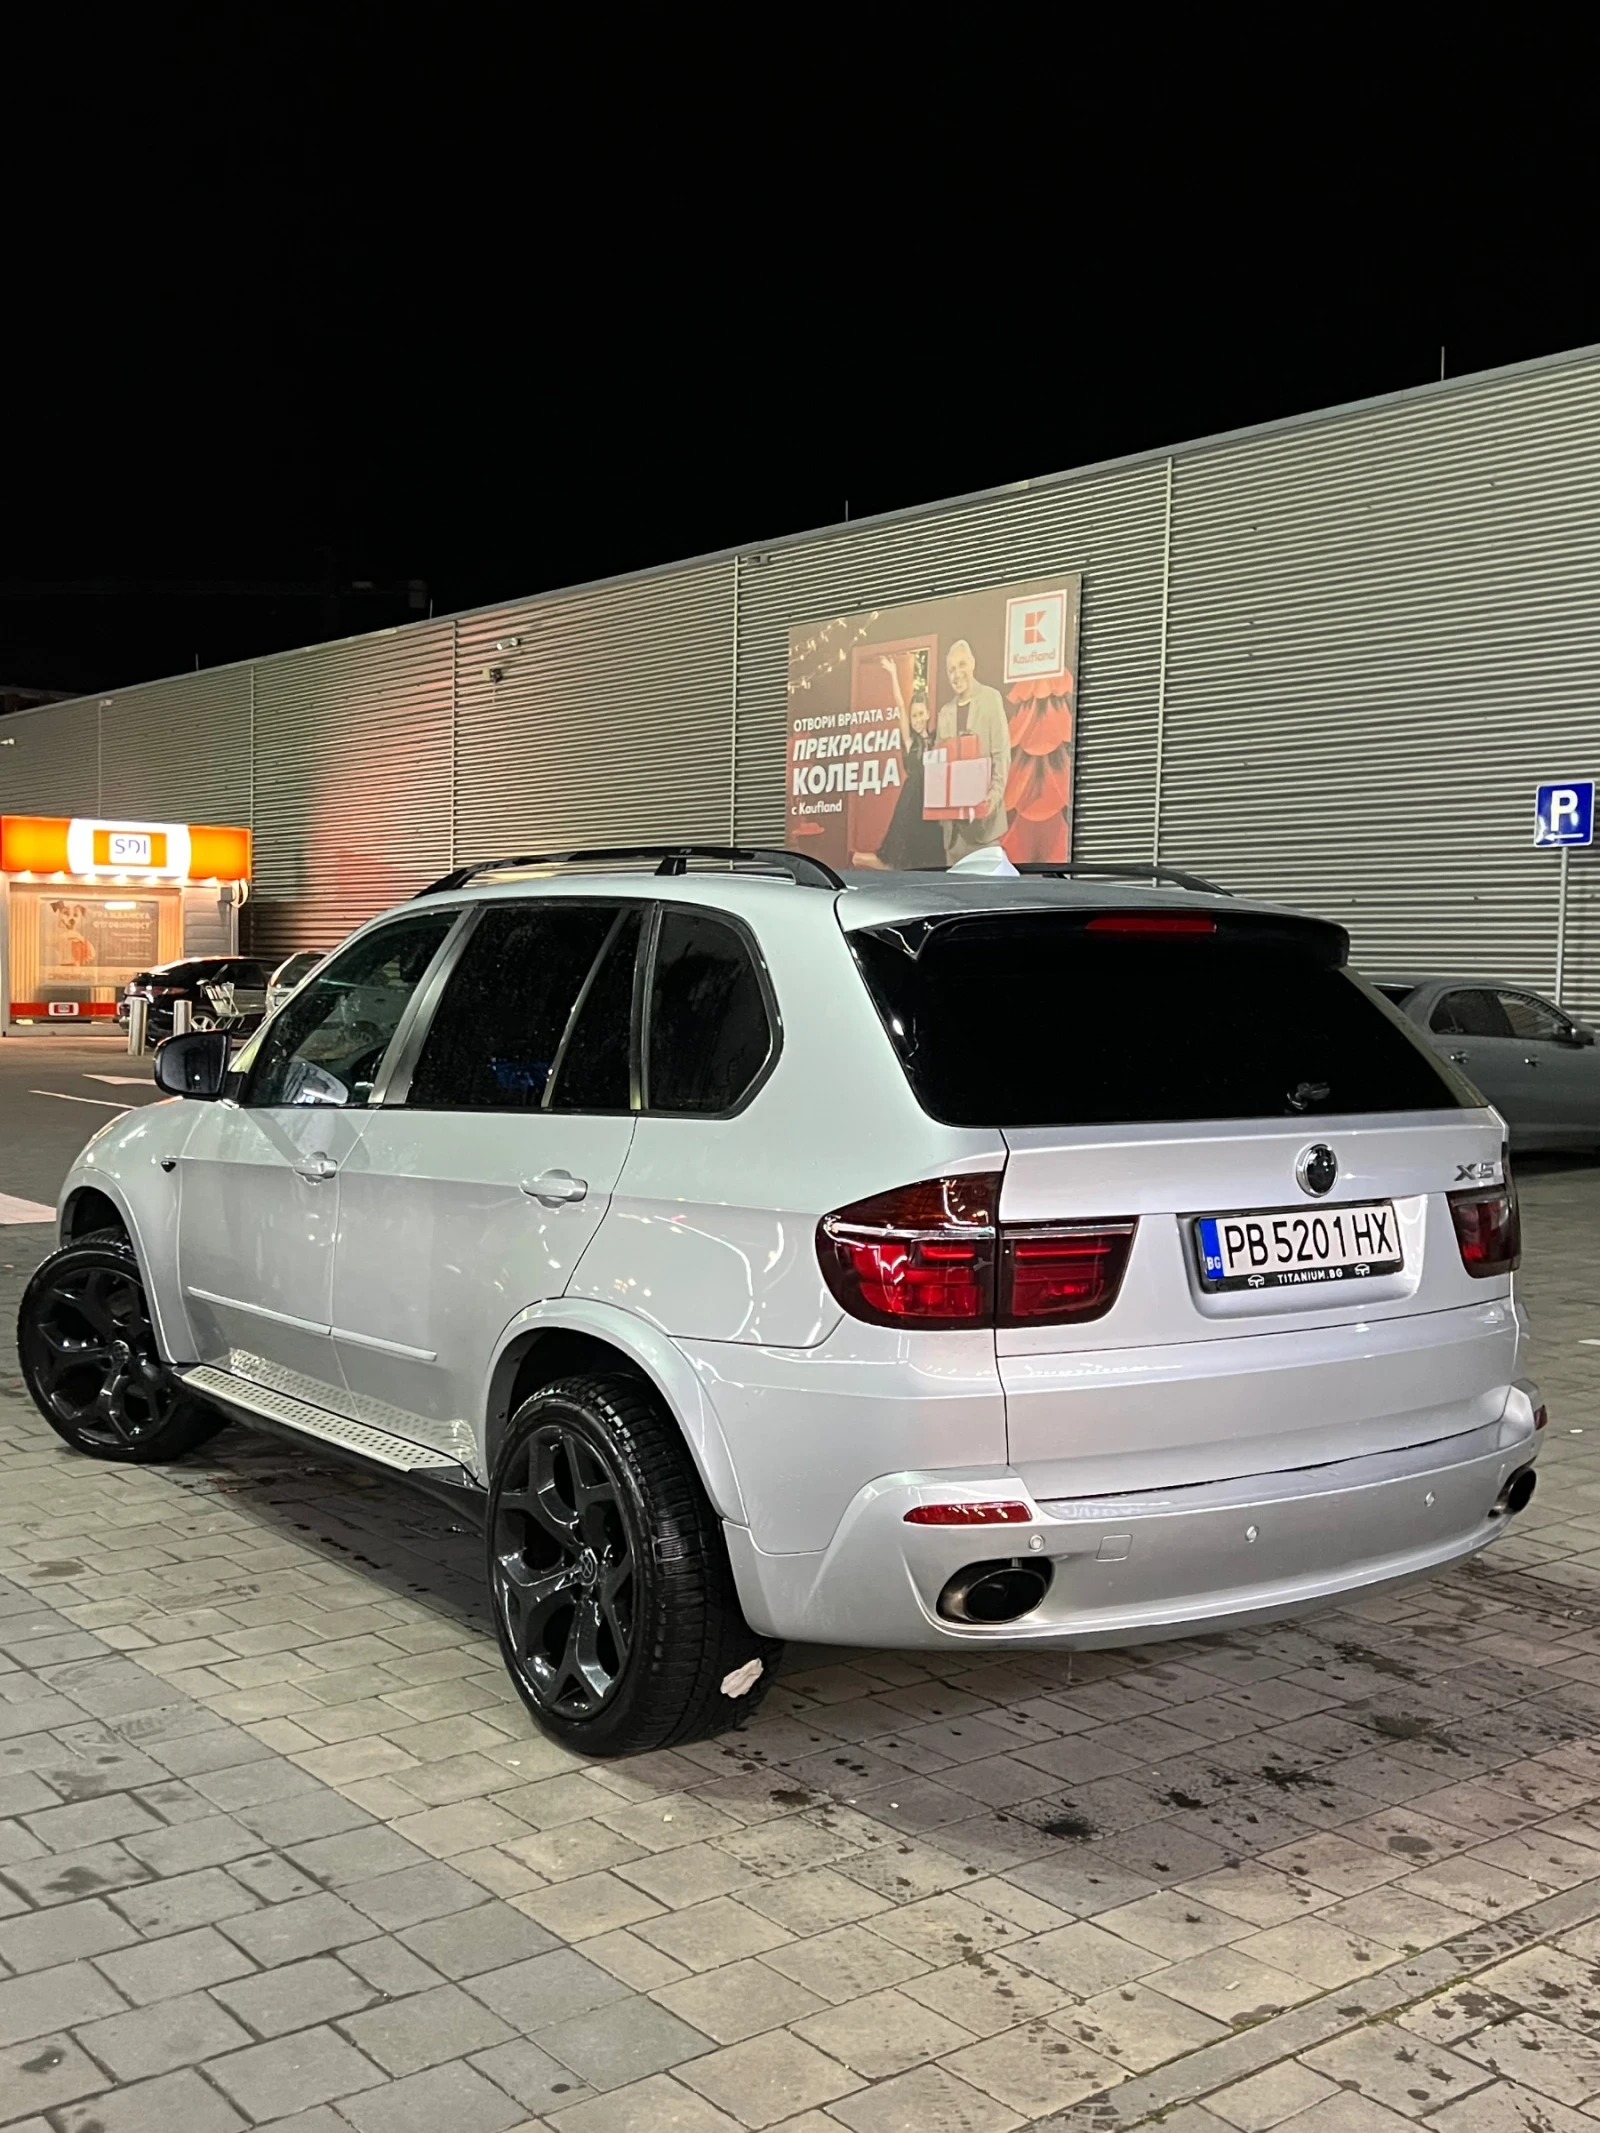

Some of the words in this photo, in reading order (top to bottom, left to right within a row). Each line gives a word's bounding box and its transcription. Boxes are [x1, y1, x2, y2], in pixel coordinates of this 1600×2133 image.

[1013, 648, 1056, 664] Kaufland
[793, 714, 836, 732] ОТВОРИ
[838, 708, 883, 727] ВРАТАТА
[886, 706, 900, 721] ЗА
[793, 728, 901, 761] ПРЕКРАСНА
[793, 758, 900, 797] КОЛЕДА
[799, 799, 842, 815] Kaufland
[1550, 789, 1578, 831] P
[115, 838, 146, 854] SDI
[1454, 1161, 1495, 1181] X5
[1224, 1223, 1268, 1268] PB
[1272, 1215, 1346, 1263] 5201
[1352, 1212, 1393, 1256] HX
[1206, 1256, 1221, 1270] BG
[1277, 1267, 1343, 1284] TITANIUM.BG
